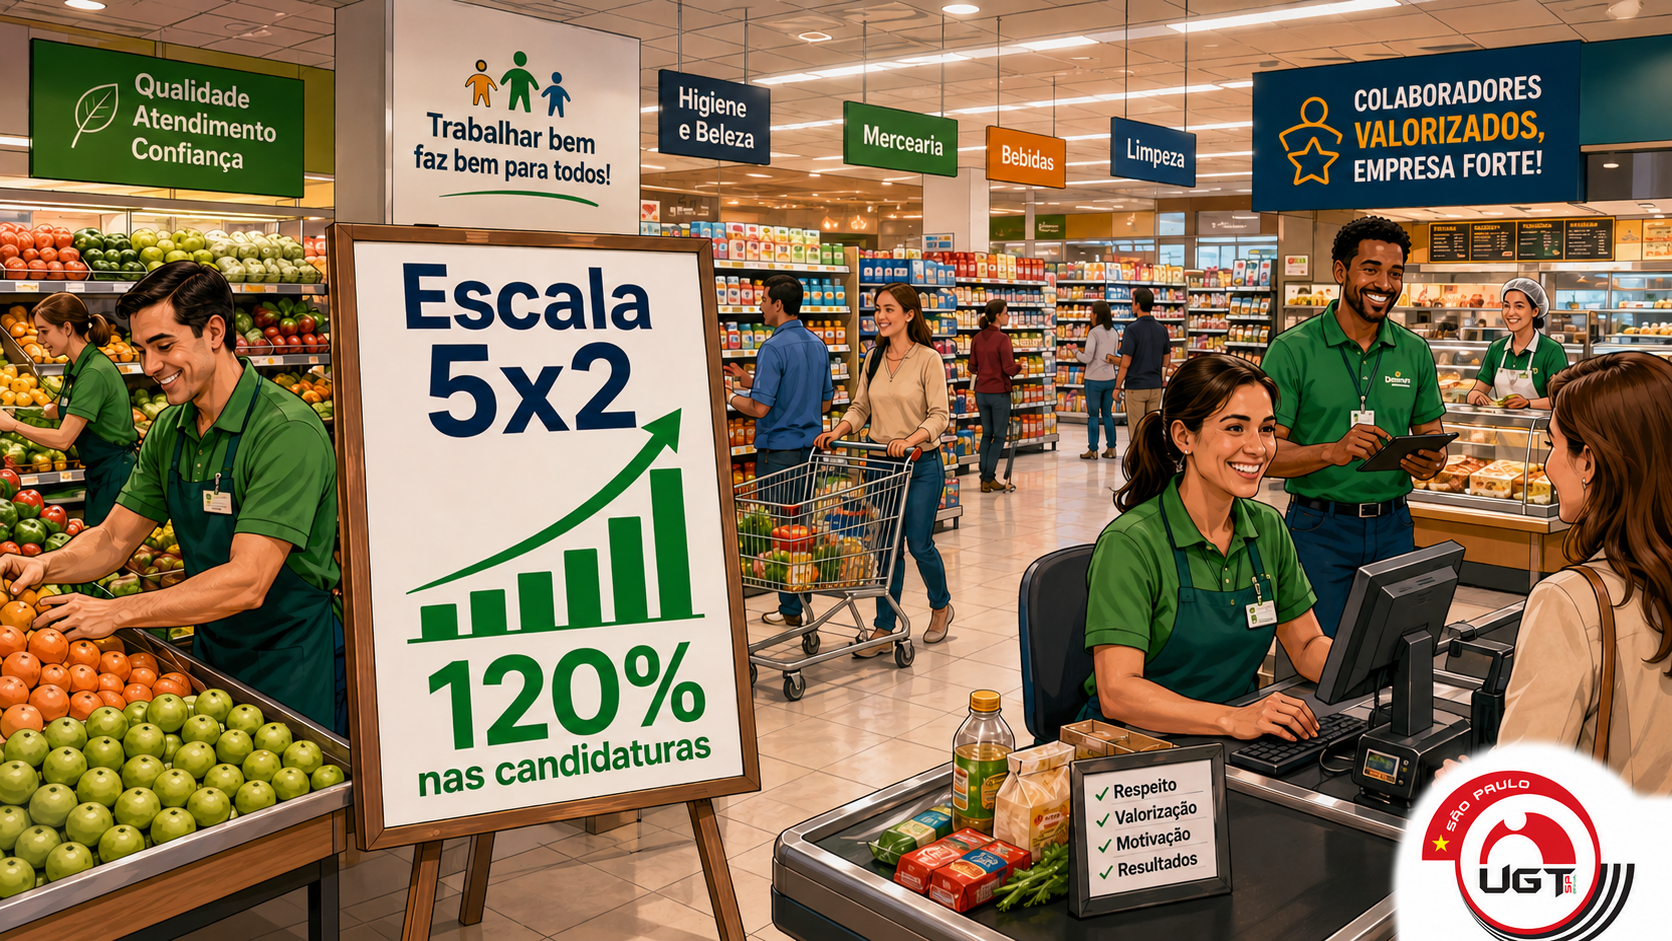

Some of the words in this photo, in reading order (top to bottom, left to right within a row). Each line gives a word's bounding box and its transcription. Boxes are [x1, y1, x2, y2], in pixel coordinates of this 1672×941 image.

[135, 73, 250, 108] Qualidade
[679, 85, 747, 118] Higiene
[1354, 75, 1542, 112] COLABORADORES
[133, 105, 277, 142] Atendimento
[427, 112, 543, 149] Trabalhar
[549, 126, 596, 155] bem
[679, 123, 691, 141] e
[696, 120, 755, 149] Beleza
[864, 123, 944, 157] Mercearia
[1355, 110, 1545, 149] VALORIZADOS,
[132, 137, 244, 173] Confiança
[414, 144, 448, 171] faz
[454, 148, 499, 175] bem
[504, 158, 549, 183] para
[553, 160, 611, 186] todos!
[1002, 144, 1055, 171] Bebidas
[1127, 137, 1185, 170] Limpeza
[1353, 155, 1456, 183] EMPRESA
[1463, 150, 1543, 178] FORTE!
[403, 263, 653, 331] Escala
[427, 341, 638, 438] 5x2
[428, 641, 706, 750] 120%
[419, 766, 486, 797] nas
[494, 736, 712, 786] candidaturas
[1113, 777, 1178, 800] Respeito
[1114, 801, 1198, 826] Valorização
[1116, 827, 1191, 852] Motivação
[1117, 853, 1198, 878] Resultados
